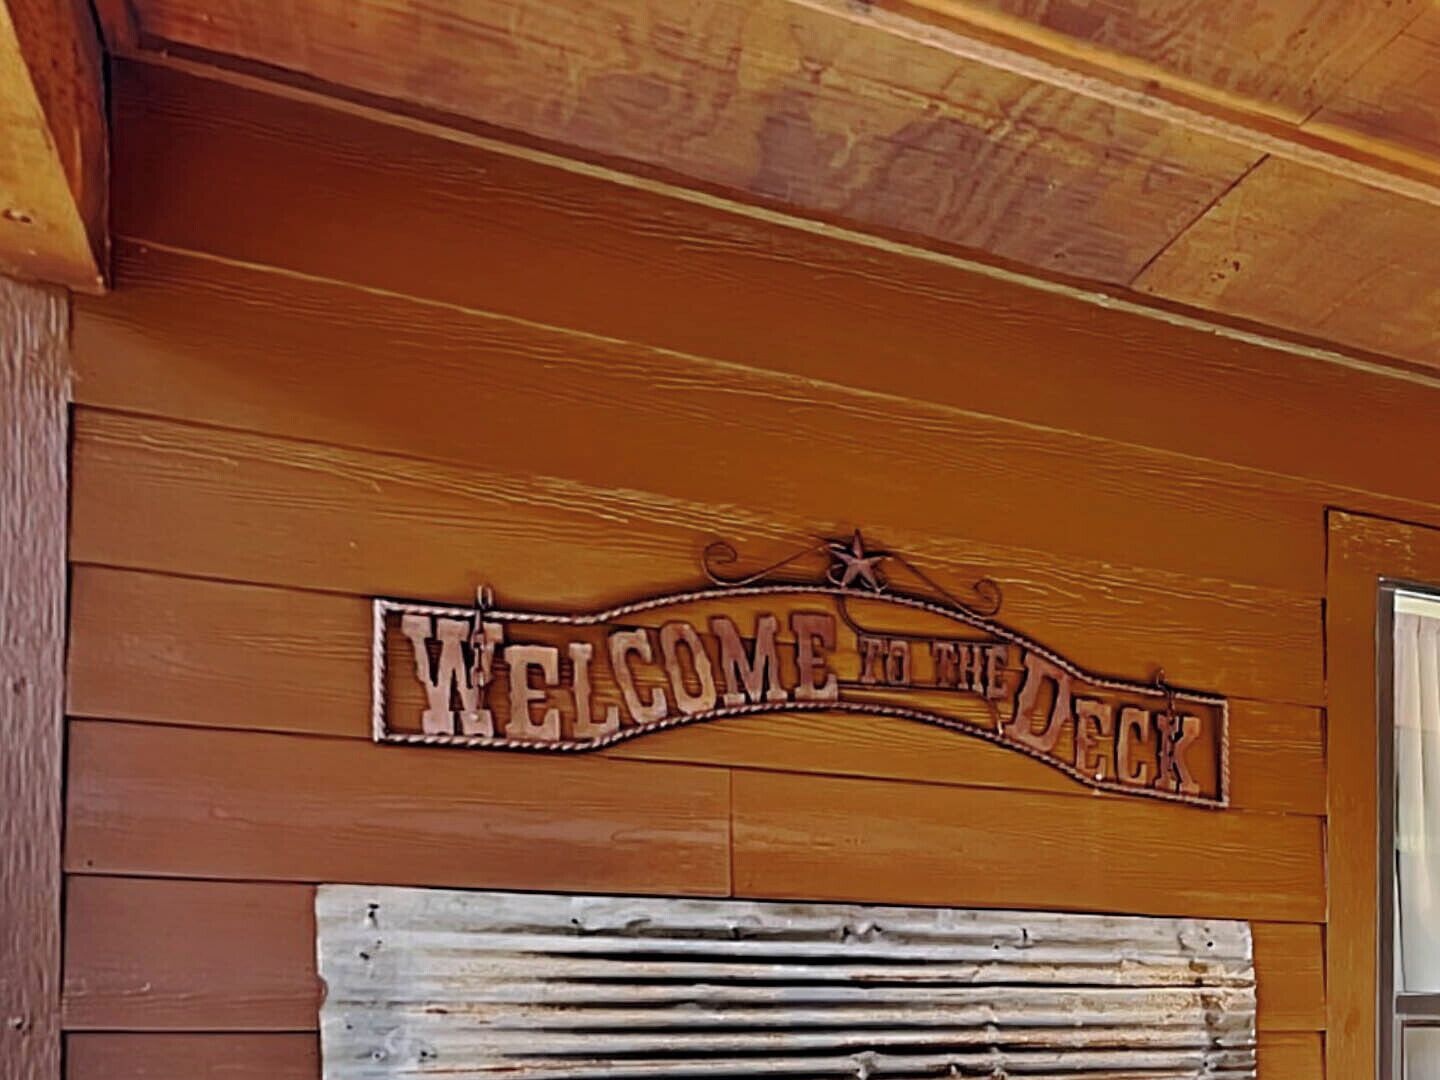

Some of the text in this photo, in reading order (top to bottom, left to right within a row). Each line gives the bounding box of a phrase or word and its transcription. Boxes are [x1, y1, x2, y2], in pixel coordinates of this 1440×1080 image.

[402, 613, 1202, 794] WELCOME TO THE DECK
